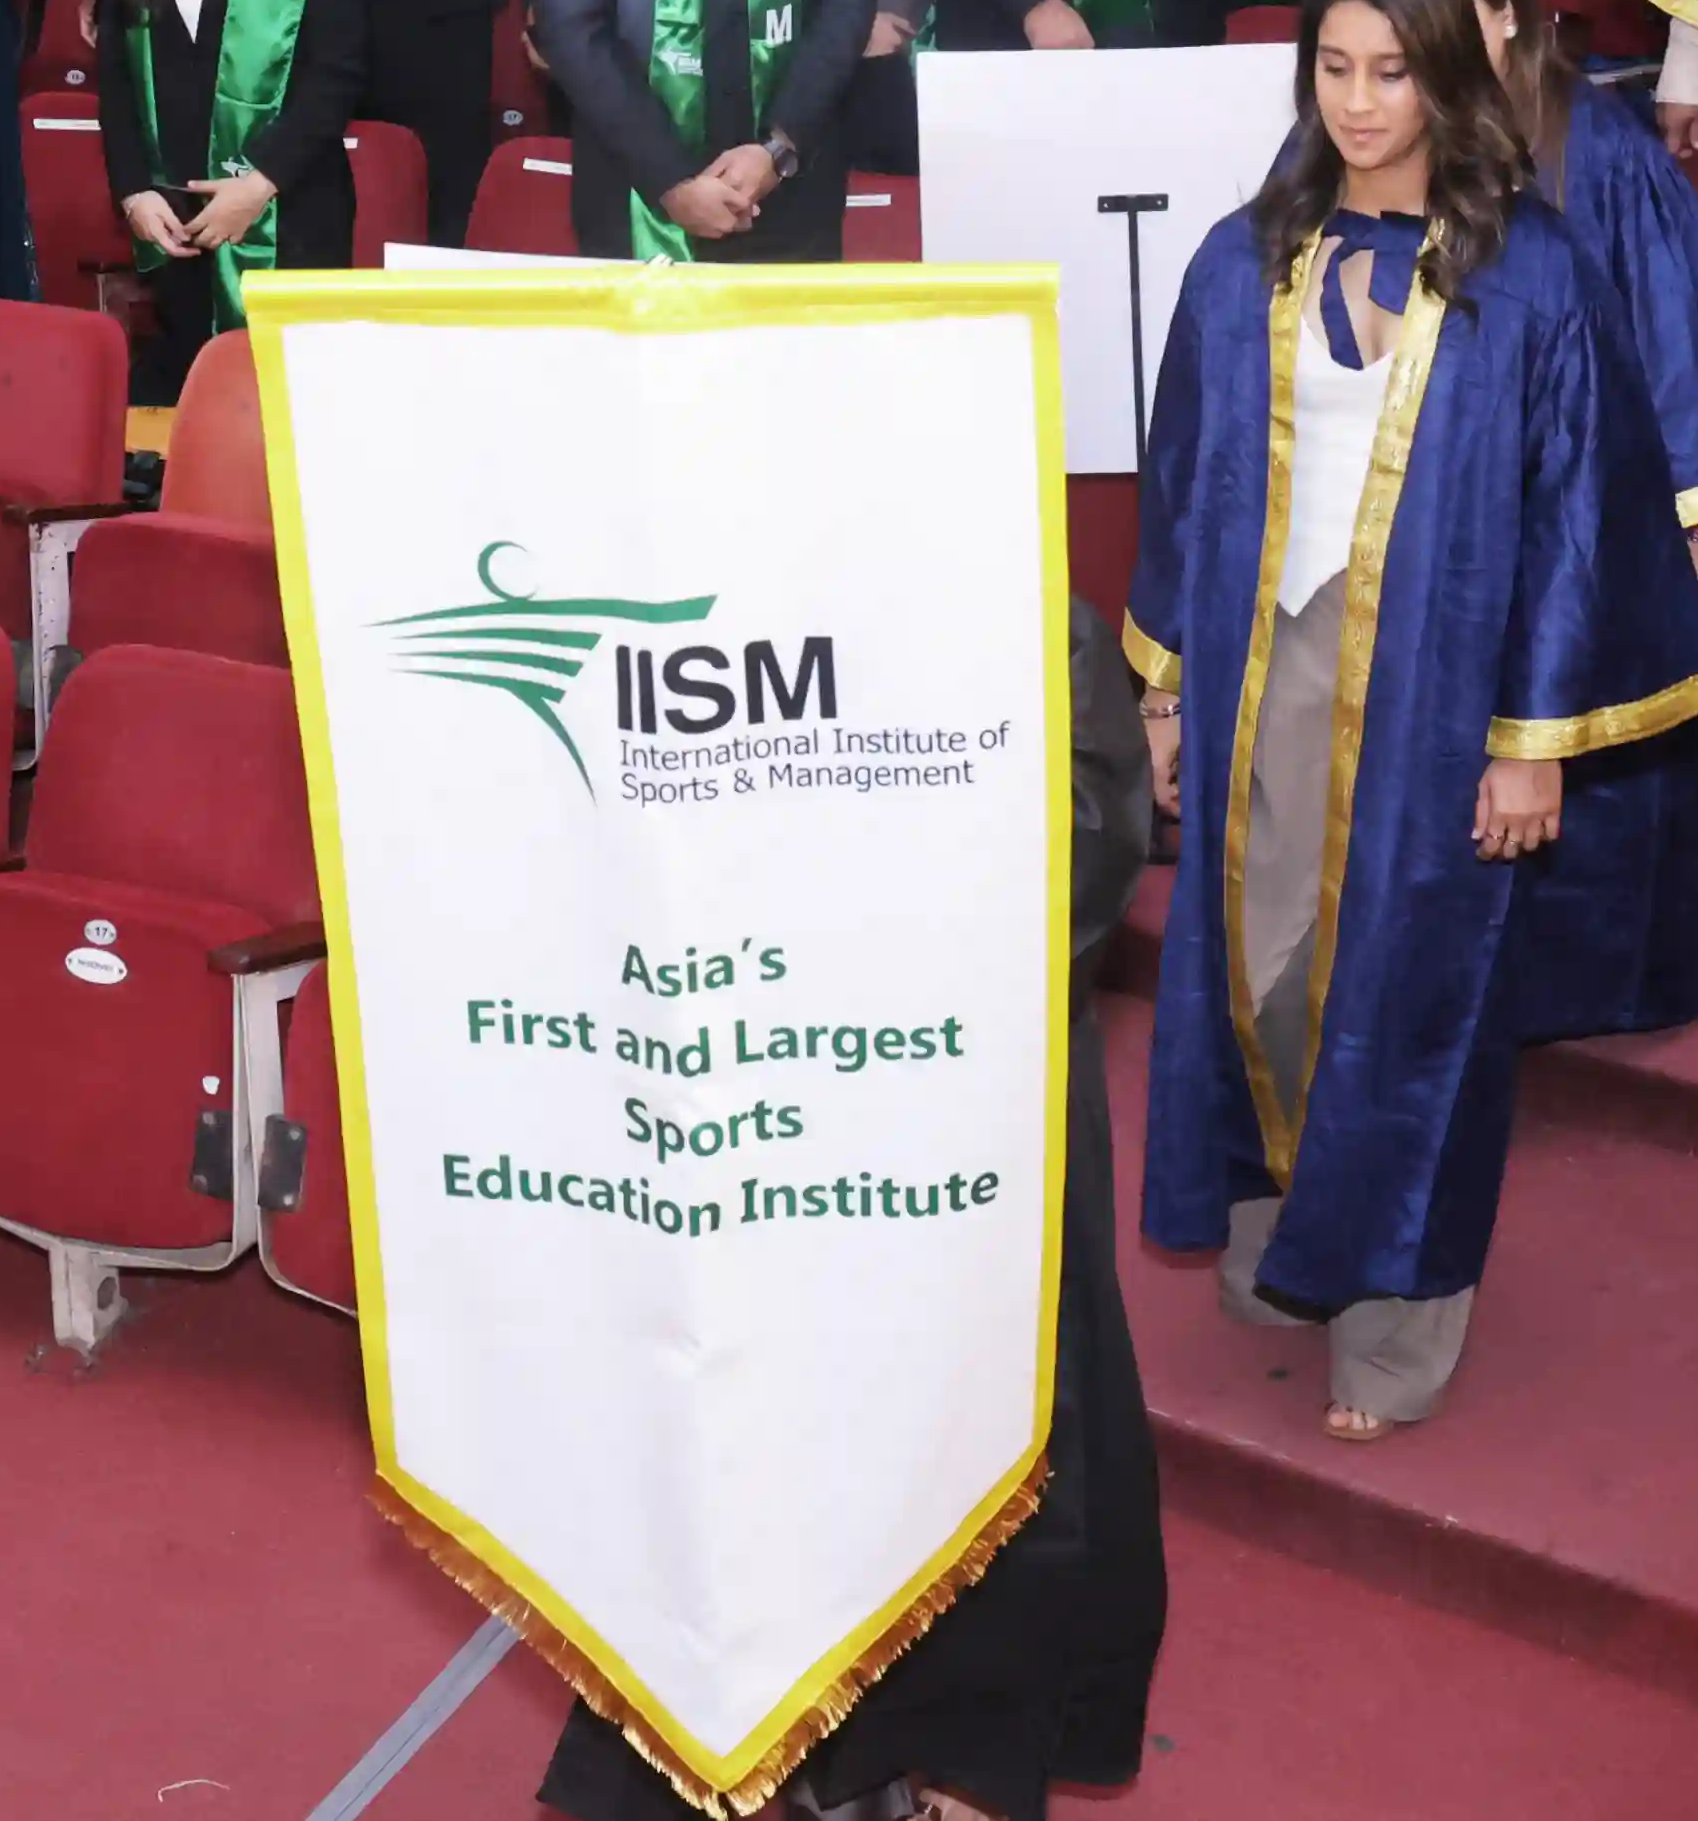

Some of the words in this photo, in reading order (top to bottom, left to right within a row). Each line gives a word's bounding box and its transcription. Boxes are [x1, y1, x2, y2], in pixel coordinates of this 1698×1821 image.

[615, 636, 839, 735] IISM
[620, 728, 819, 771] International
[833, 728, 967, 754] Institute
[979, 720, 1011, 751] of
[621, 772, 720, 807] Sports
[733, 769, 756, 794] &
[768, 760, 975, 792] Management
[621, 937, 787, 998] Asia's
[467, 998, 597, 1054] First
[615, 1026, 711, 1078] and
[735, 1016, 964, 1073] Largest
[624, 1097, 804, 1165] Sports
[443, 1153, 721, 1238] Education
[740, 1171, 999, 1224] Institute
